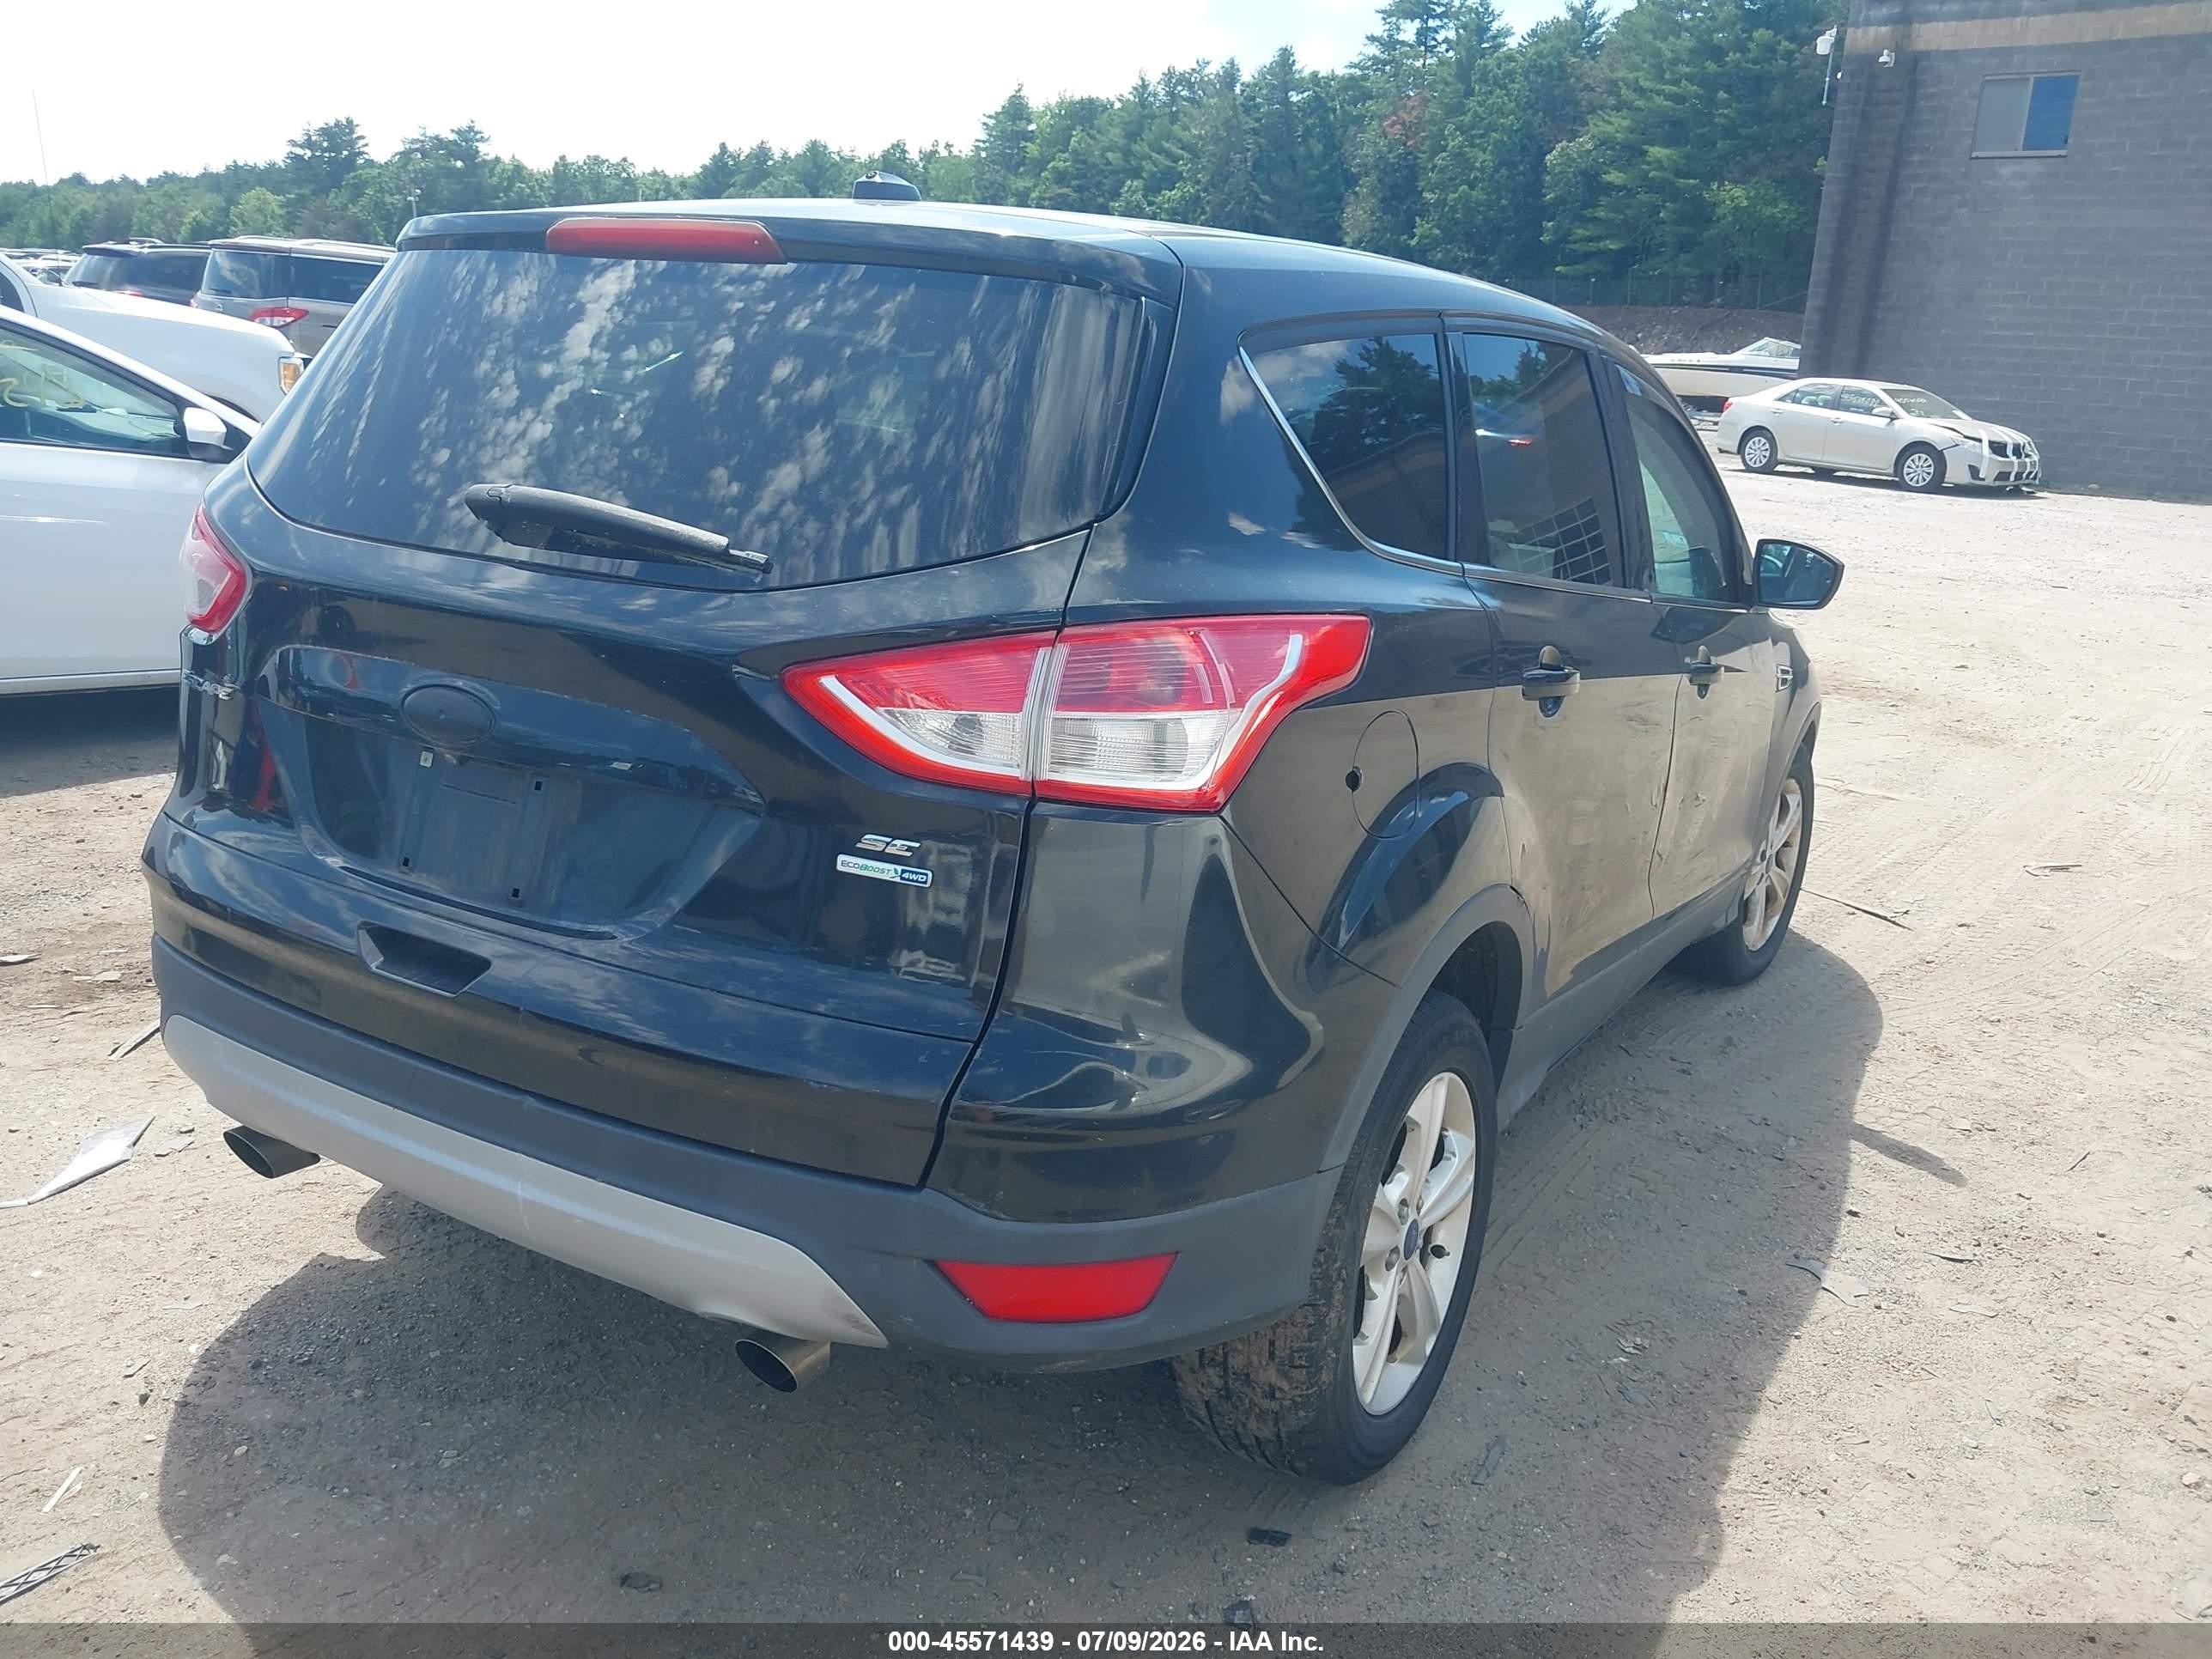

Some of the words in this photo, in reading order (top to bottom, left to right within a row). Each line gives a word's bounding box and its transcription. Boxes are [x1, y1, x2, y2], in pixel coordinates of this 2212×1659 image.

[855, 834, 921, 857] SE
[840, 860, 893, 876] ECOBOOST
[902, 871, 927, 883] 4WD
